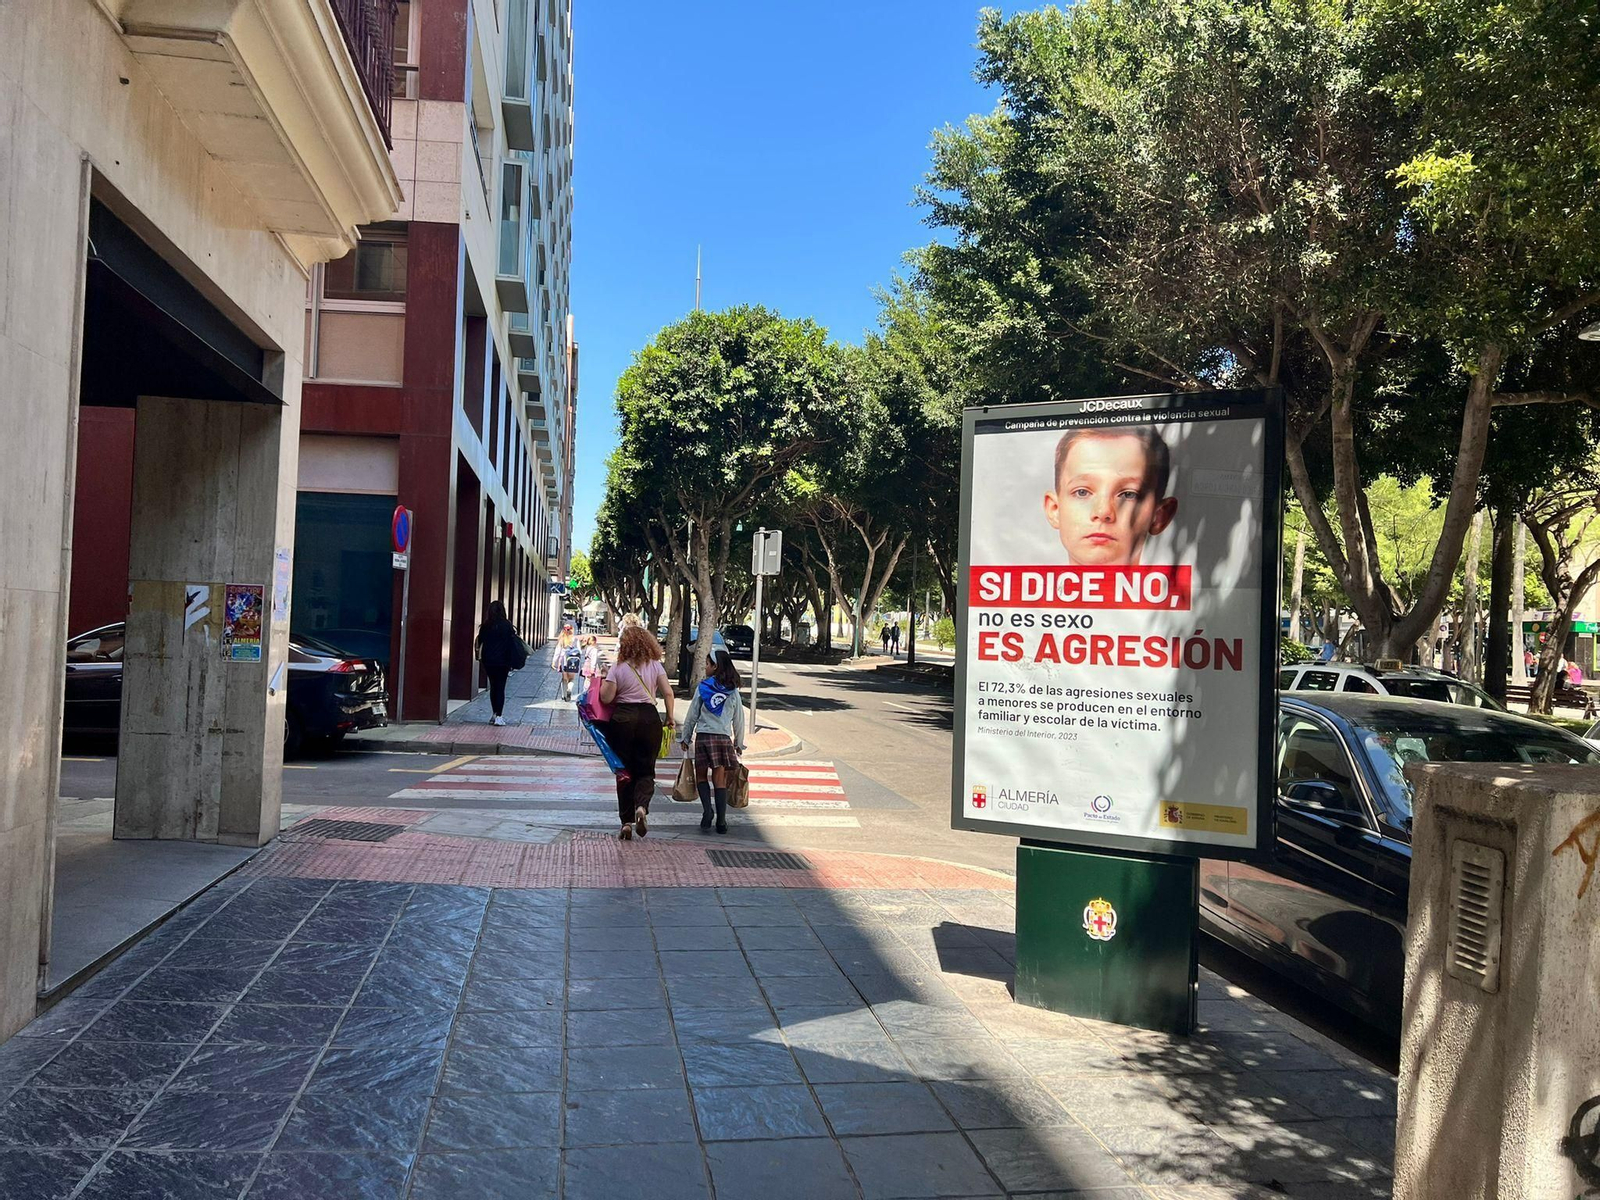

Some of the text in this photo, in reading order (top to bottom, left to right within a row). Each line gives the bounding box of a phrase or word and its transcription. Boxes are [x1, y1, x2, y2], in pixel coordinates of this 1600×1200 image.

[1080, 399, 1142, 412] JCDecaux
[1005, 407, 1230, 430] Campaña de prevención contra la violencia sexual
[979, 571, 1180, 608] SI DICE NO,
[978, 612, 1094, 629] no es sexo
[978, 629, 1243, 671] ES AGRESIÓN
[978, 682, 1194, 703] El 72,3% de las agresiones sexuales
[978, 698, 1202, 719] a menores se producen en el entorno
[978, 710, 1161, 732] familiar y escolar de la víctima.
[978, 726, 1014, 736] Ministerio
[1014, 729, 1026, 737] del
[1058, 732, 1078, 741] 2023
[998, 788, 1060, 805] ALMERÍA
[998, 800, 1030, 812] CIUDAD
